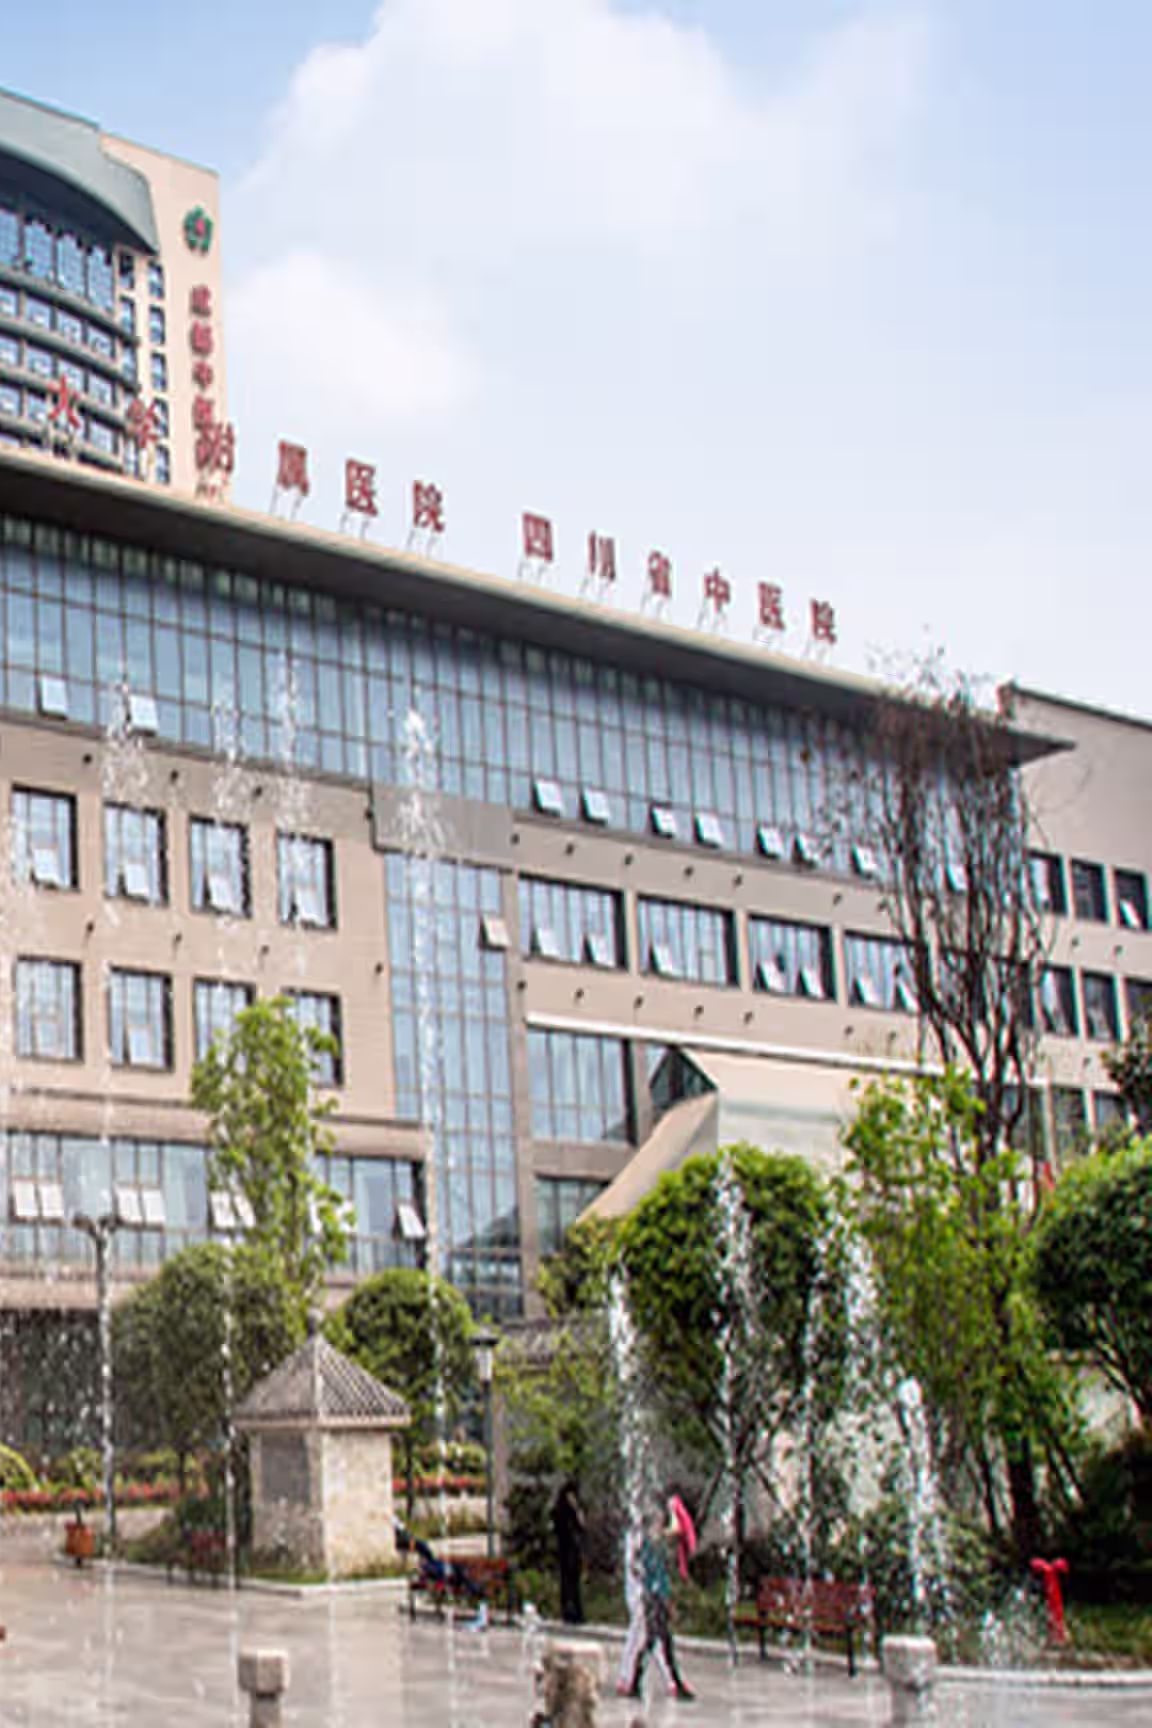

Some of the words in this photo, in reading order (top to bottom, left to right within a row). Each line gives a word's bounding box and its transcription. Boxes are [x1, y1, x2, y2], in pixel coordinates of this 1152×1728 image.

[522, 511, 837, 645] 四川省中医院
